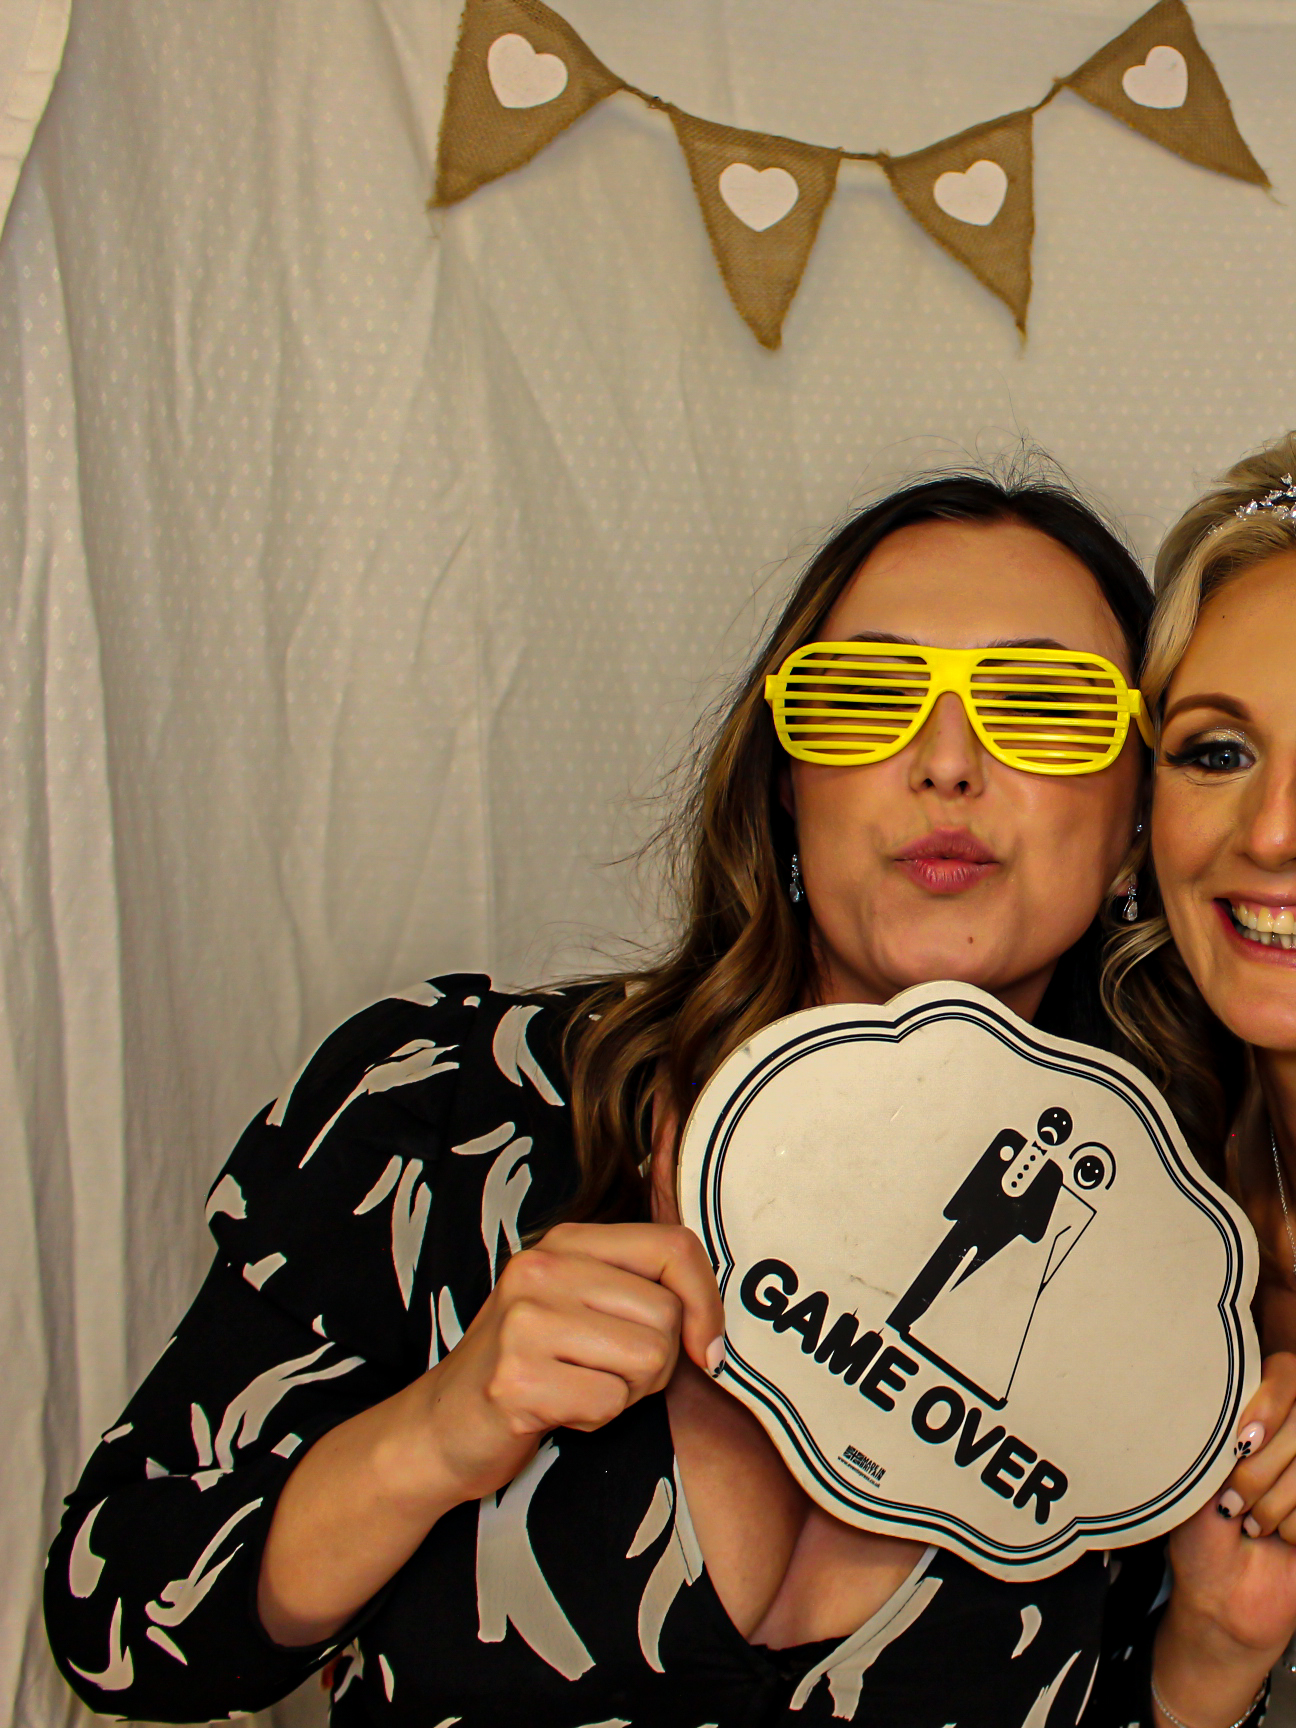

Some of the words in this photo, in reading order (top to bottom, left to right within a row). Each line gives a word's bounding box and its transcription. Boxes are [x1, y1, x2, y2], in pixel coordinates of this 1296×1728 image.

[740, 1258, 920, 1412] GAME
[911, 1385, 1068, 1524] OVER
[859, 1461, 883, 1481] BRITAIN
